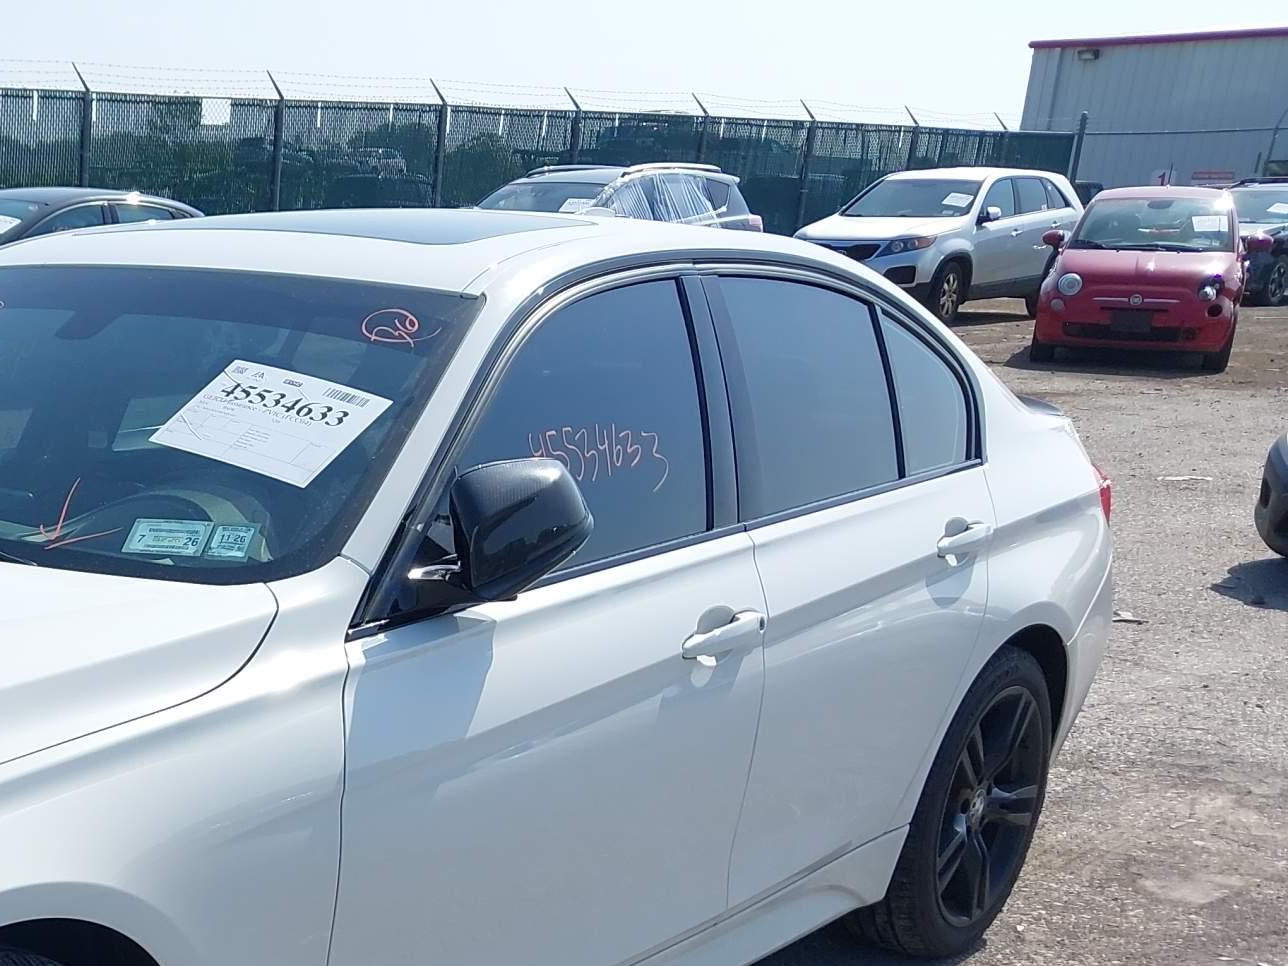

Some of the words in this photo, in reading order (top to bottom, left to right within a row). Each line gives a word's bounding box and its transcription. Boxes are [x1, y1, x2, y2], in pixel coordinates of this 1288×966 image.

[221, 382, 350, 428] 45534633
[529, 423, 669, 493] 45534633
[182, 537, 200, 547] 26
